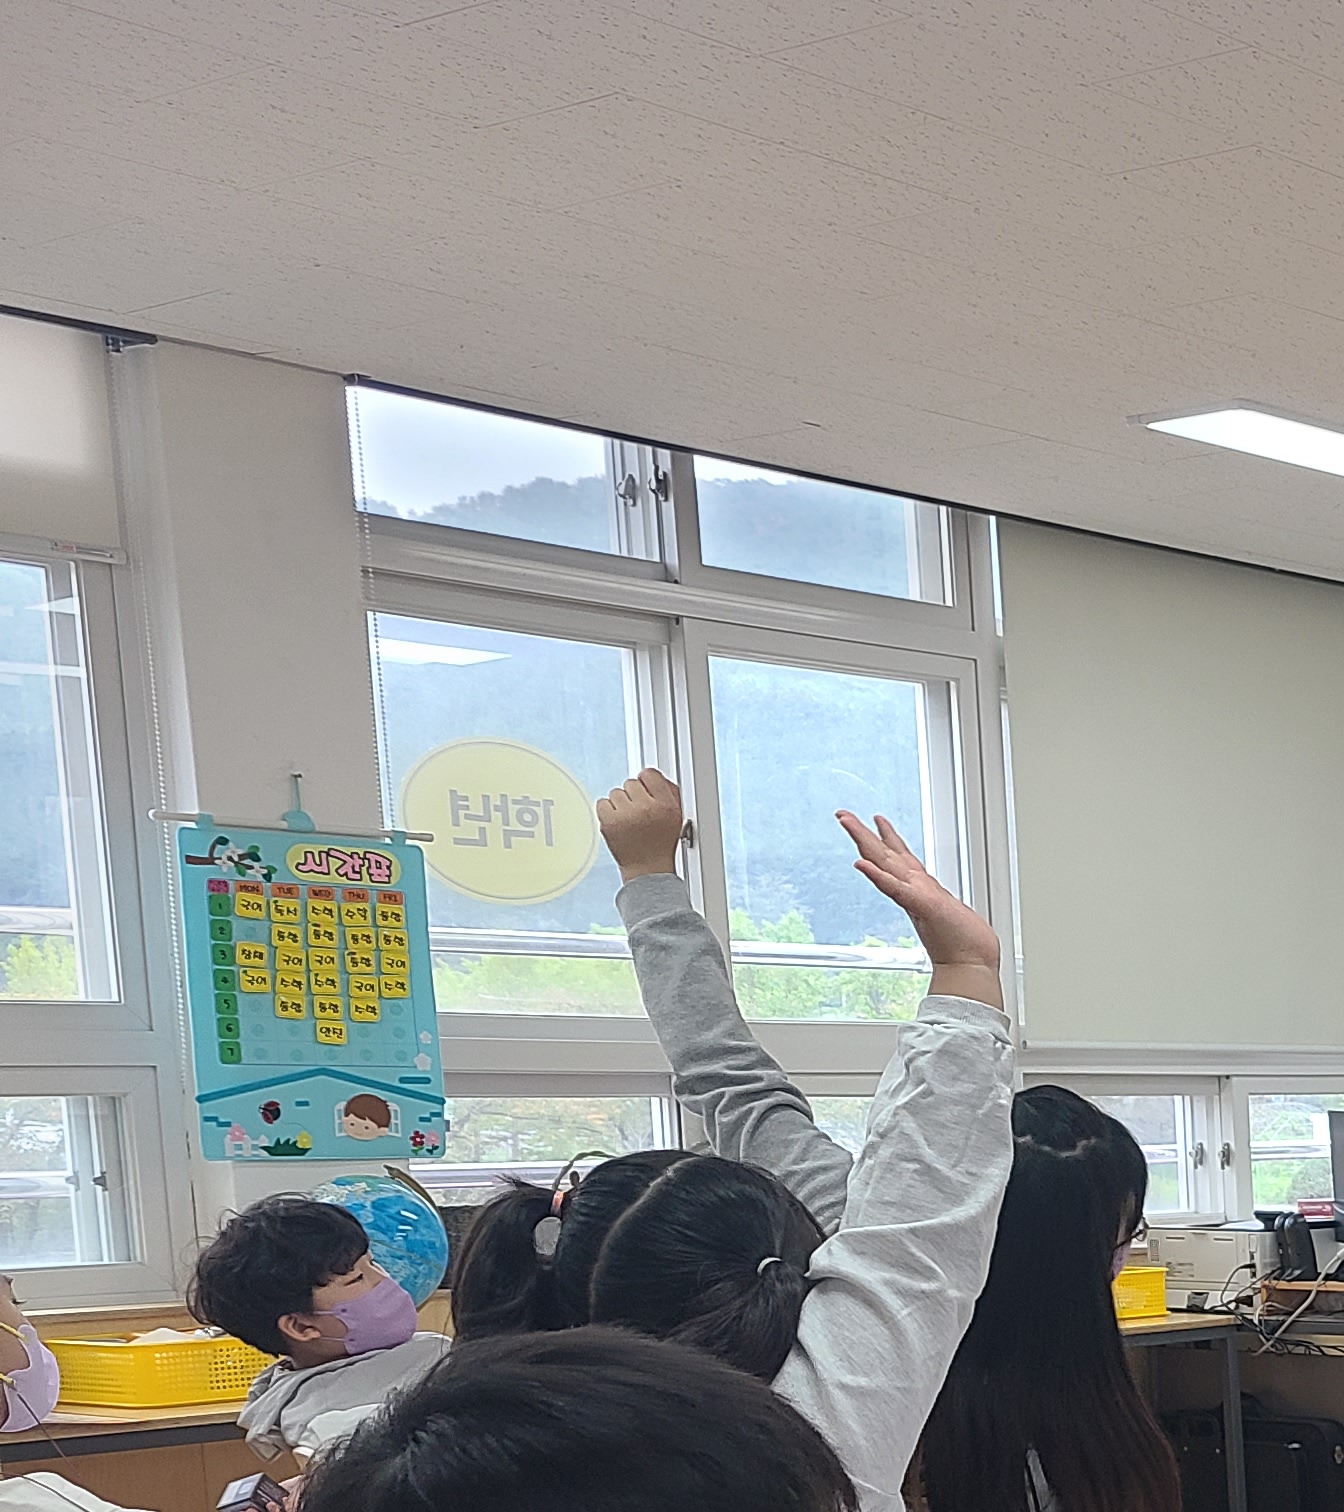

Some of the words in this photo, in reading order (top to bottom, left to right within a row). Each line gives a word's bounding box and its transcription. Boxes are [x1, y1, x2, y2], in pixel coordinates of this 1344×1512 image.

[295, 848, 392, 884] 시간표
[240, 884, 260, 893] MON
[277, 886, 294, 895] TUE
[311, 889, 331, 898] WED
[347, 891, 365, 900] THU
[383, 893, 398, 902] FRI
